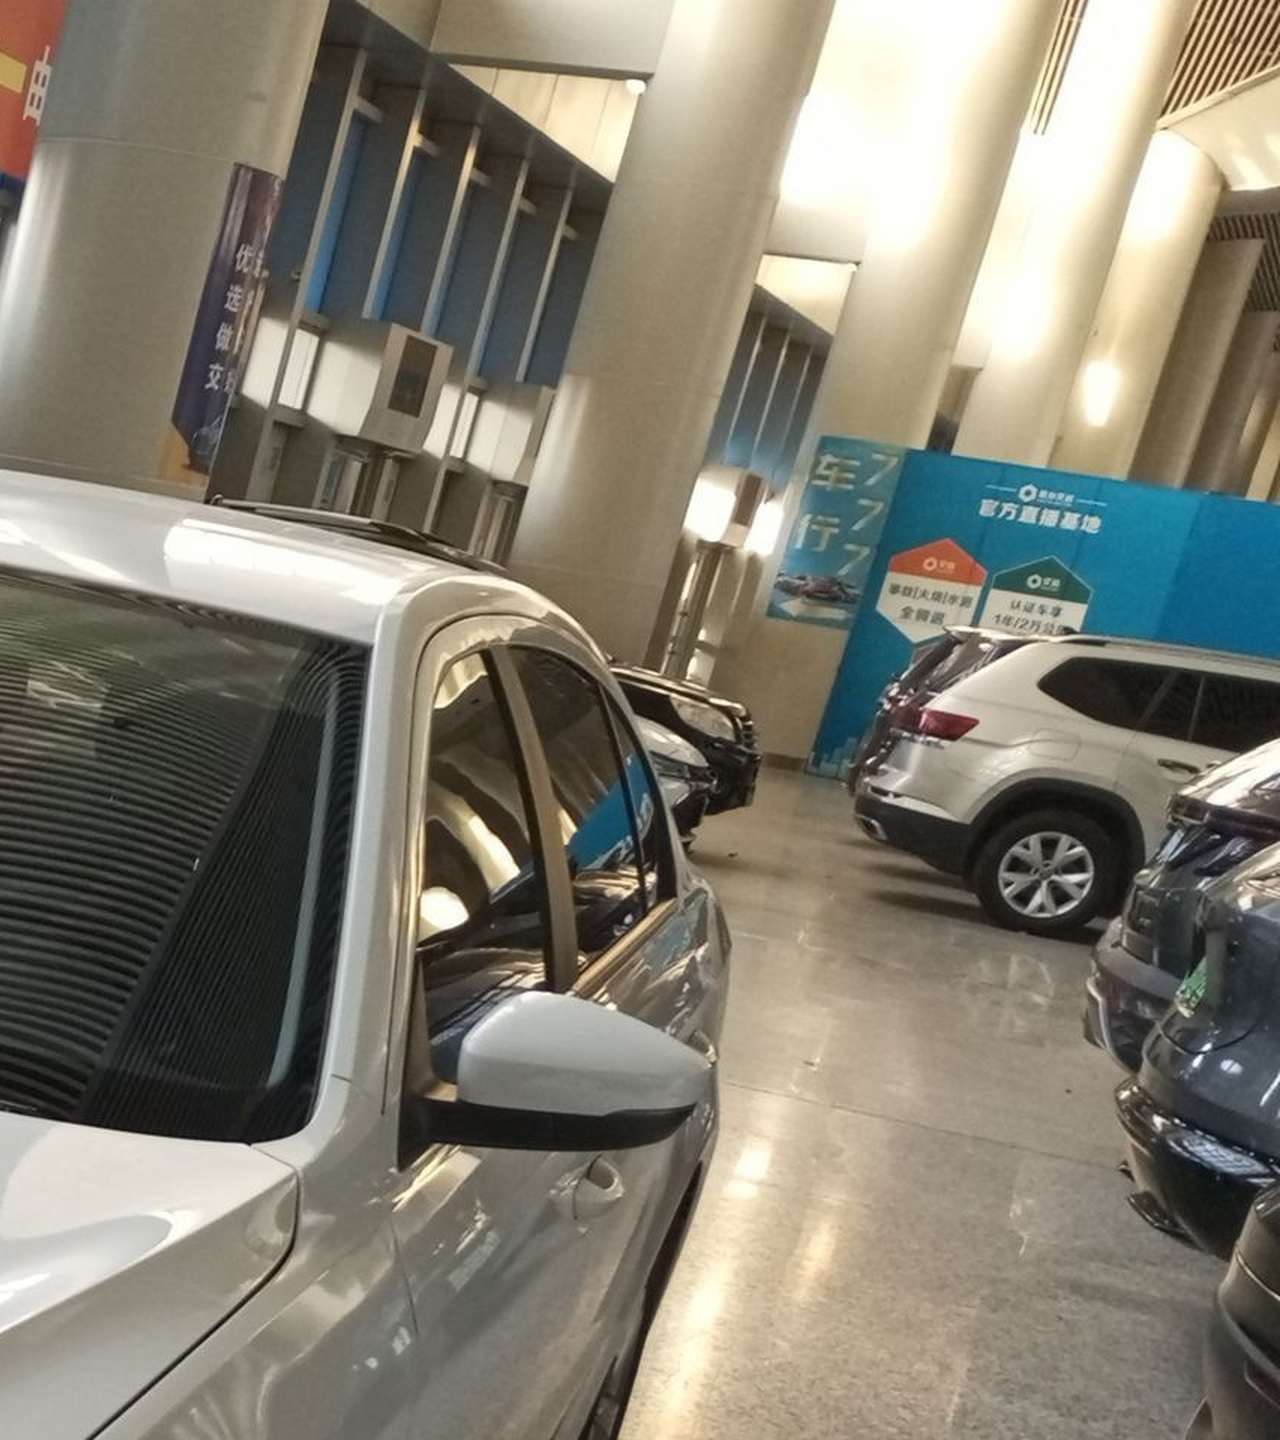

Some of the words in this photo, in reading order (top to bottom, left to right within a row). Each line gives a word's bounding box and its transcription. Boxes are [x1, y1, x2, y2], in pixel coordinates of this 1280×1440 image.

[794, 453, 861, 552] 车行
[979, 498, 1102, 534] 官方直播基地
